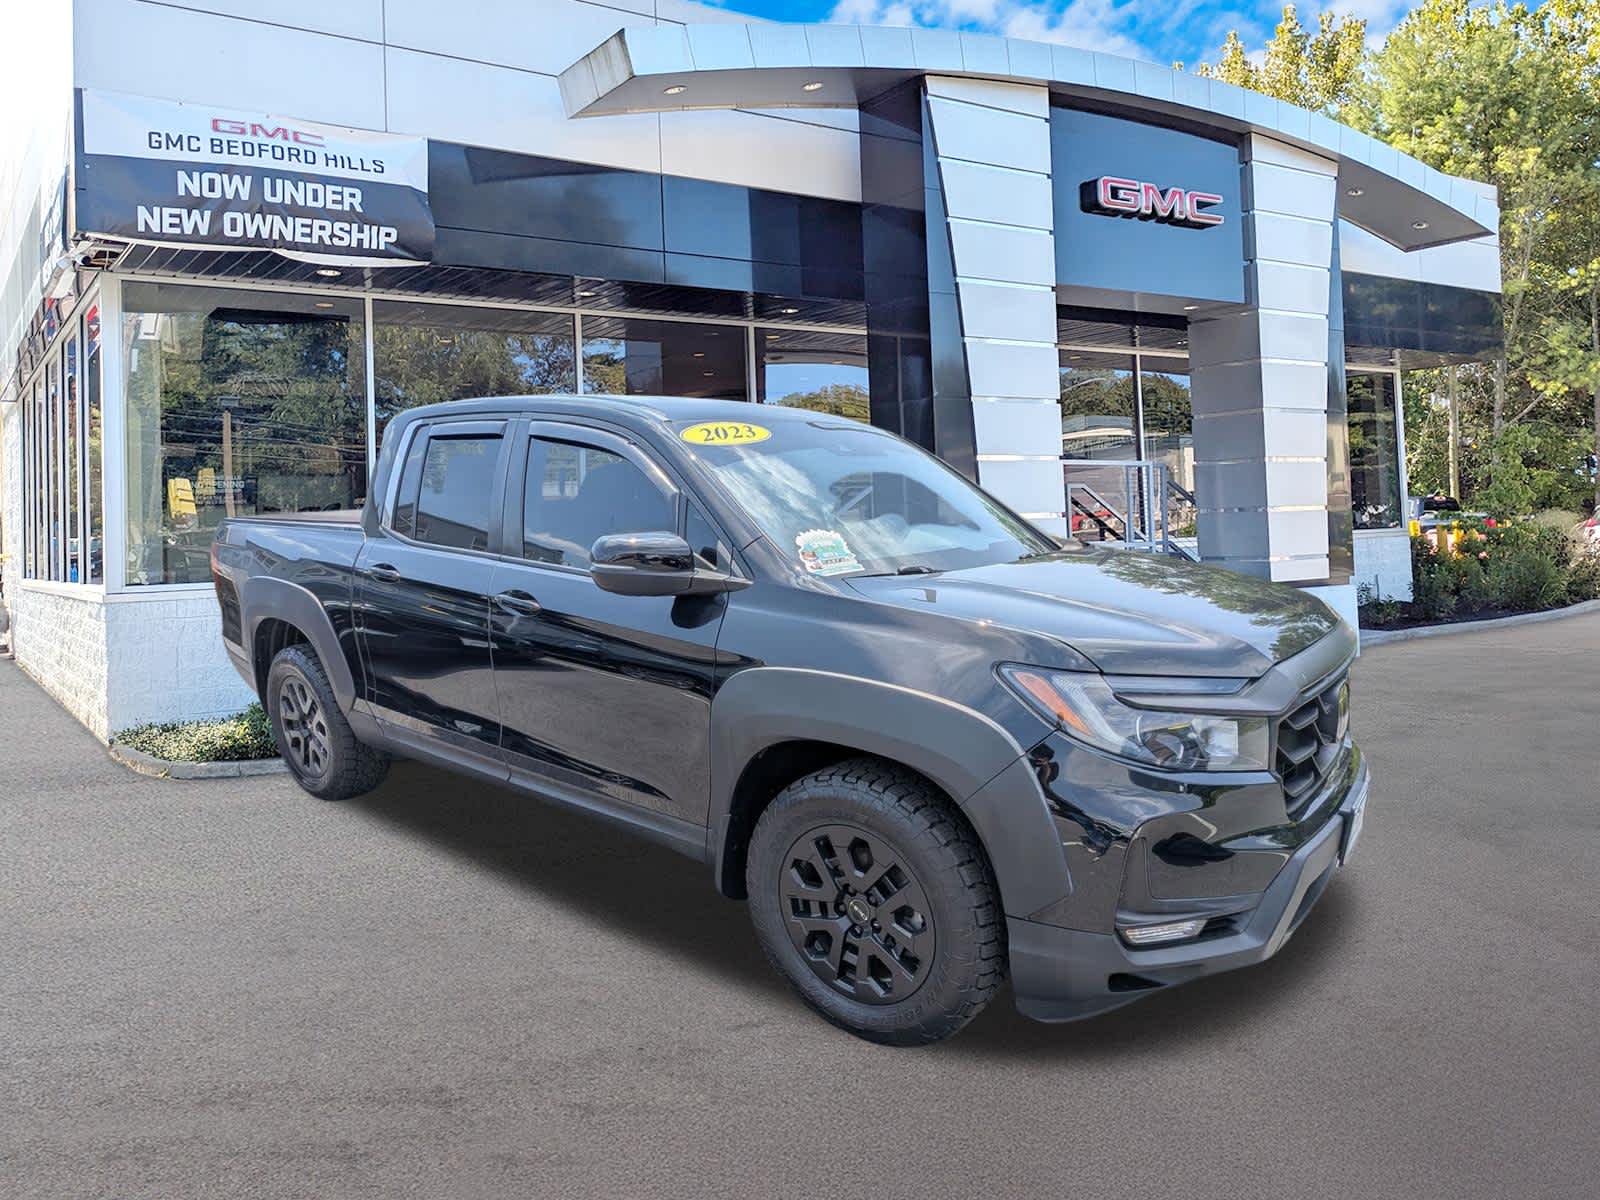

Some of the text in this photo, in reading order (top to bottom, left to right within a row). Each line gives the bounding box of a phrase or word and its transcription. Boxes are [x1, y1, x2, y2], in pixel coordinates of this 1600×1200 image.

[148, 131, 385, 174] GMC BEDFORD HILLS
[211, 118, 326, 148] GMC
[177, 170, 364, 213] NOW UNDER
[1097, 175, 1225, 225] GMC
[137, 205, 398, 251] NEW OWNERSHIP
[699, 425, 757, 442] 2023
